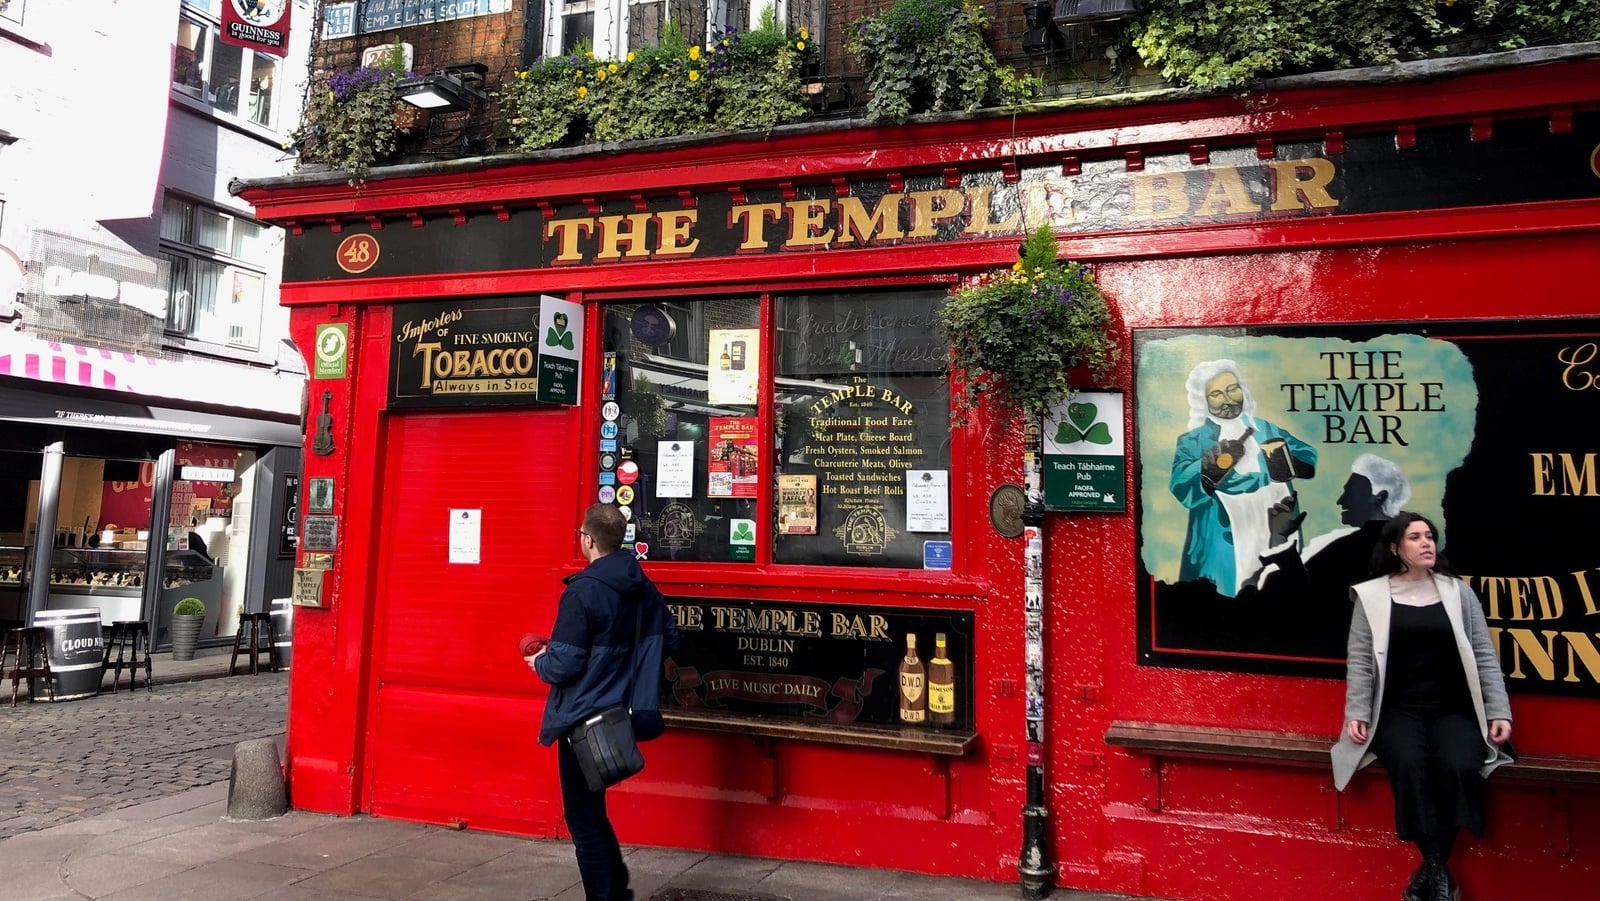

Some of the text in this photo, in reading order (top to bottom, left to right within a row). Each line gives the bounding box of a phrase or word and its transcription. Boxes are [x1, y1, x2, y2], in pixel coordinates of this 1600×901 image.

[360, 13, 401, 29] EMPE
[440, 1, 481, 17] SOUTH
[231, 22, 281, 41] GUINNESS
[267, 38, 280, 46] you
[546, 157, 1340, 265] THE TEMPLE BAR
[343, 240, 371, 264] 48
[397, 308, 462, 342] Importers
[797, 301, 940, 336] Traditional
[437, 328, 449, 337] OF
[454, 331, 534, 345] FINE SMOKING
[867, 337, 944, 363] Music
[319, 367, 342, 375] Member
[320, 360, 341, 368] Official
[413, 342, 534, 390] TOBACCO
[1320, 350, 1404, 380] THE
[554, 371, 563, 379] Pub
[853, 376, 867, 384] The
[435, 378, 536, 393] Always in Stoc
[811, 385, 913, 416] TEMPLE BAR
[1280, 382, 1446, 412] TEMPLE
[809, 416, 913, 426] Traditional Food Fare
[815, 432, 913, 443] Meat Plate, Cheese Board
[1322, 414, 1409, 447] BAR
[805, 446, 923, 457] Fresh Oysters, Smoked Salmon
[814, 458, 913, 469] Charcuterie Meats, Olives
[1052, 461, 1076, 470] Teach
[825, 471, 901, 481] Toasted Sandwiches
[1076, 472, 1092, 480] Pub
[823, 485, 837, 494] Hot
[840, 485, 861, 494] Roast
[863, 485, 881, 495] Beef
[884, 485, 904, 495] Rolls
[1459, 575, 1564, 621] TED
[667, 604, 893, 642] HE TEMPLE BAR
[61, 638, 93, 652] CLOUD
[737, 637, 795, 653] DUBLIN
[743, 655, 789, 668] EST. 1840
[711, 679, 739, 690] LIVE
[784, 682, 822, 697] DAILY
[902, 675, 922, 687] D.W.D.
[930, 684, 953, 692] JAMESON
